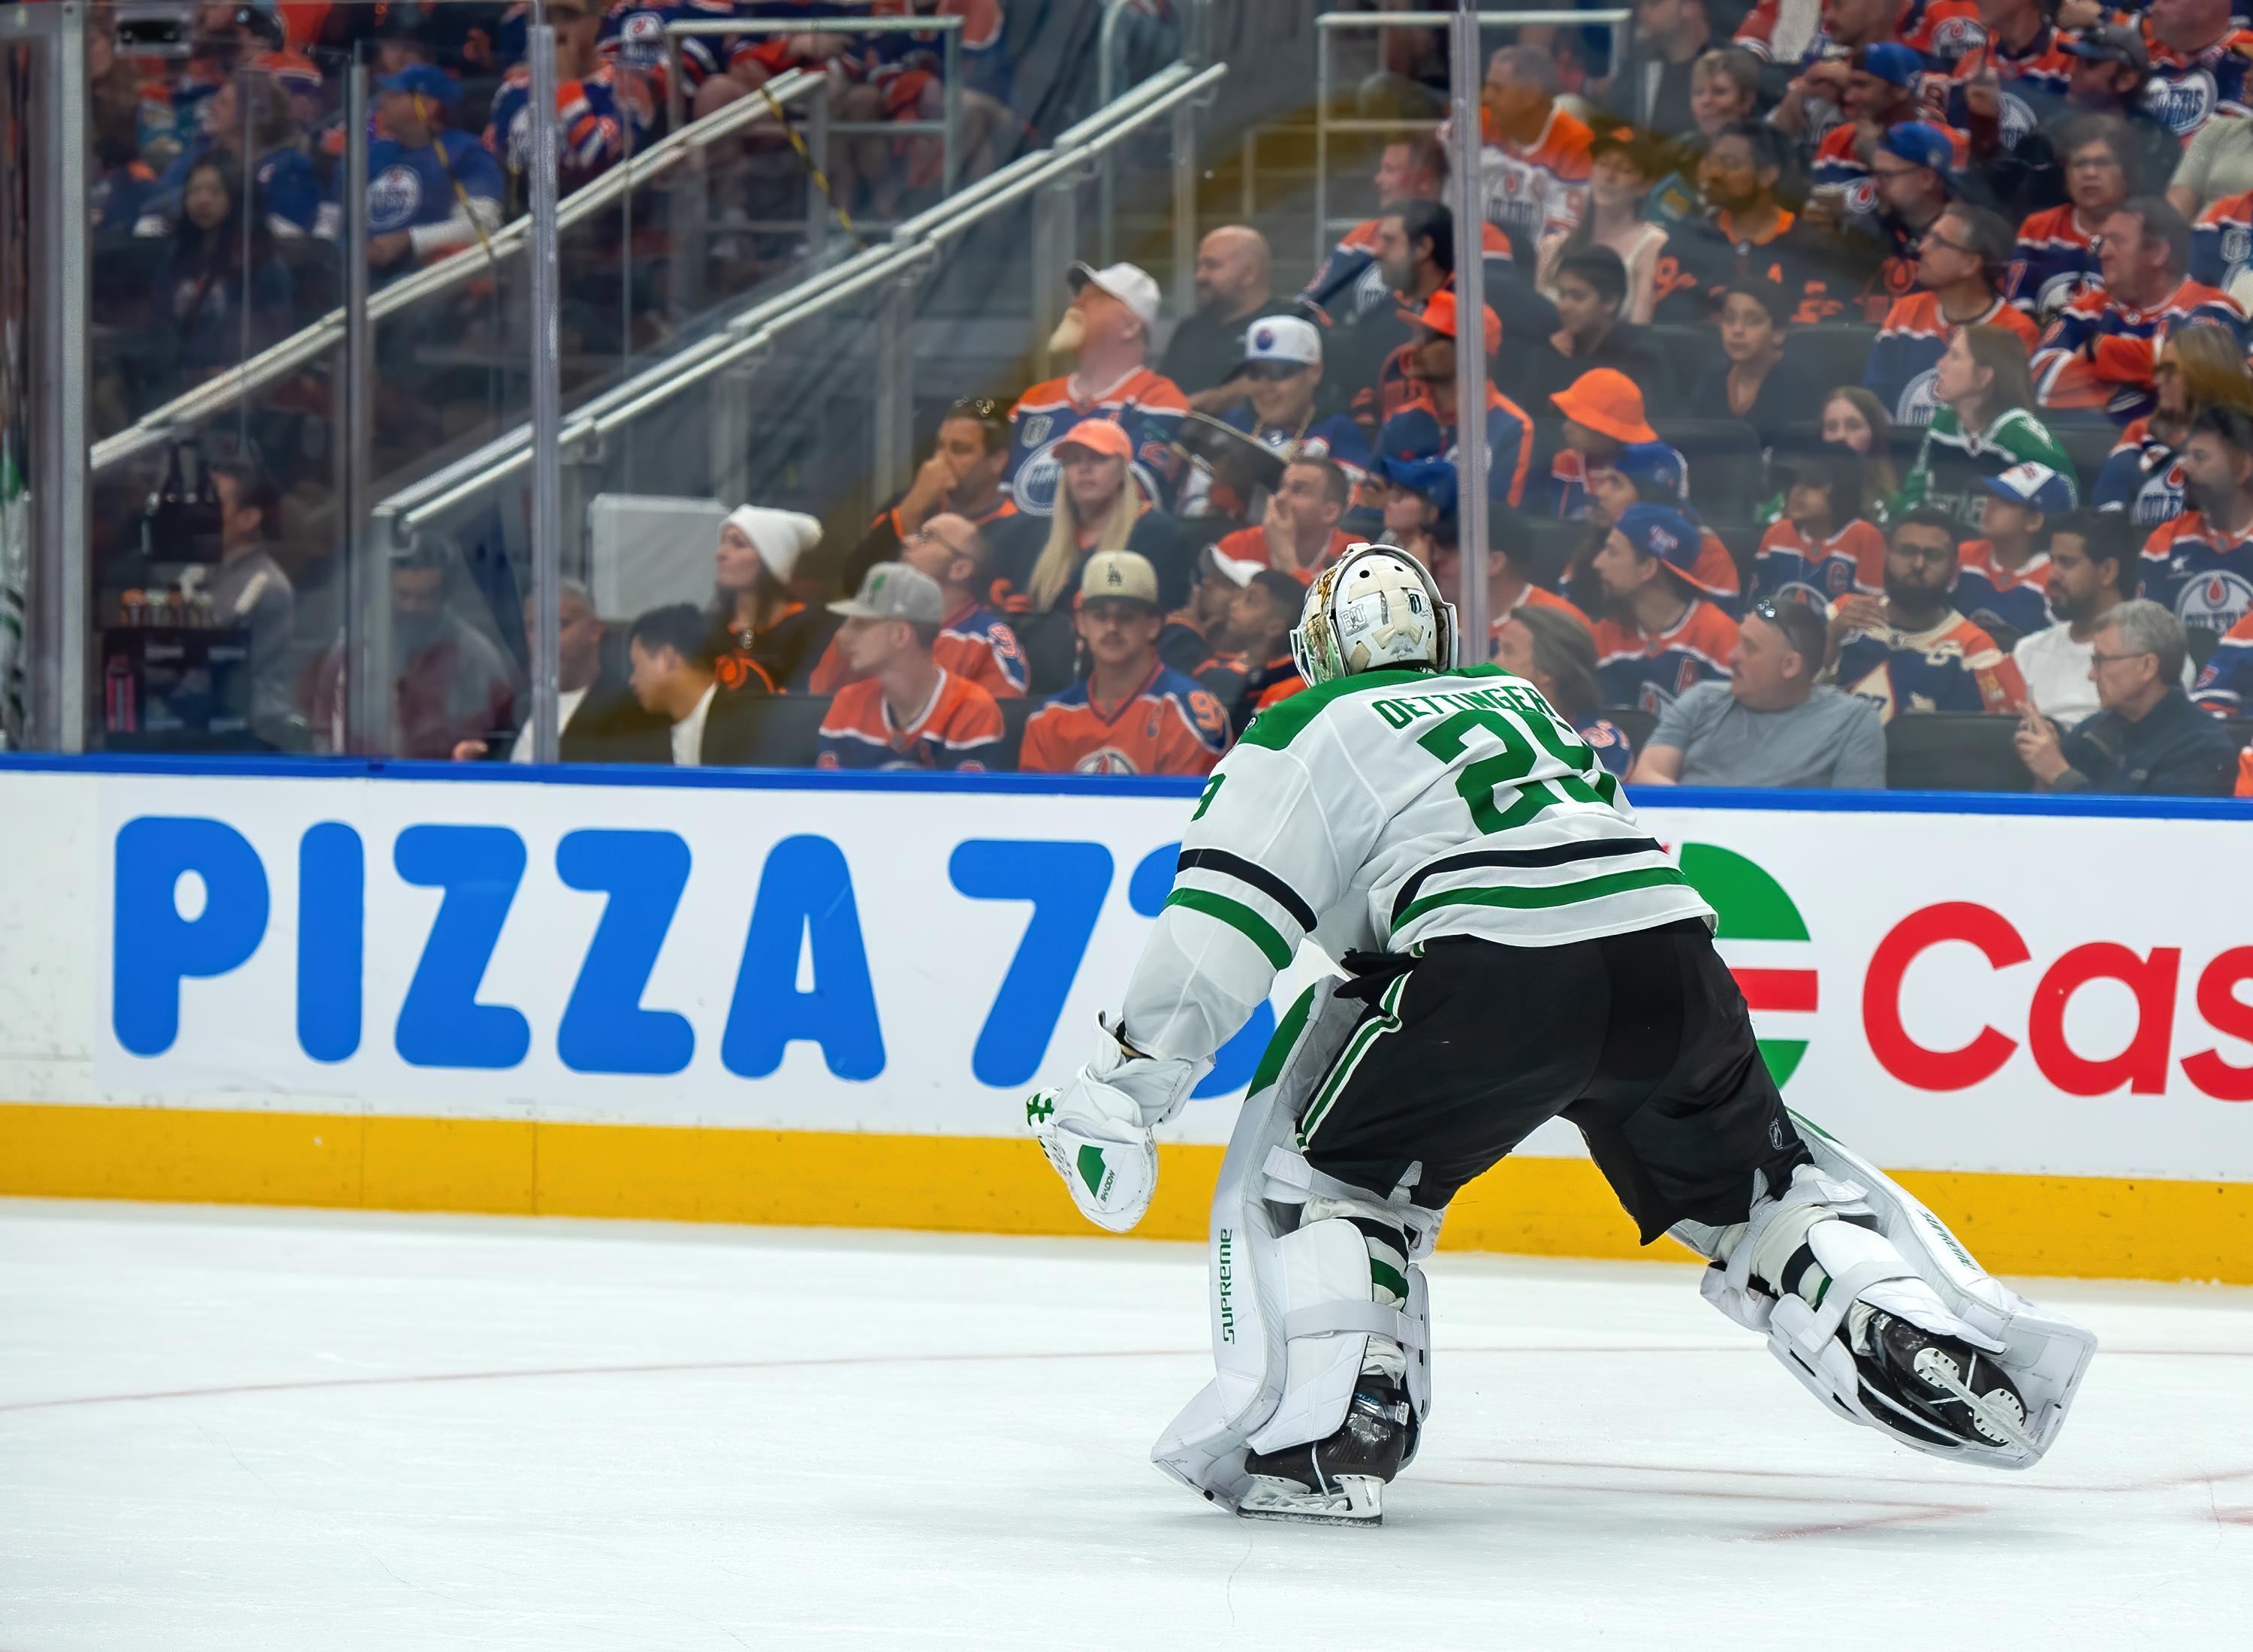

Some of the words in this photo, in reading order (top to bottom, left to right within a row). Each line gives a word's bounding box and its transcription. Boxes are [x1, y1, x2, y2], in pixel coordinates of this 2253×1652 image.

[1371, 686, 1557, 730] OETTINGER
[1416, 709, 1618, 835] 29
[112, 815, 886, 1082] PIZZA
[1220, 1228, 1235, 1345] SUPREME
